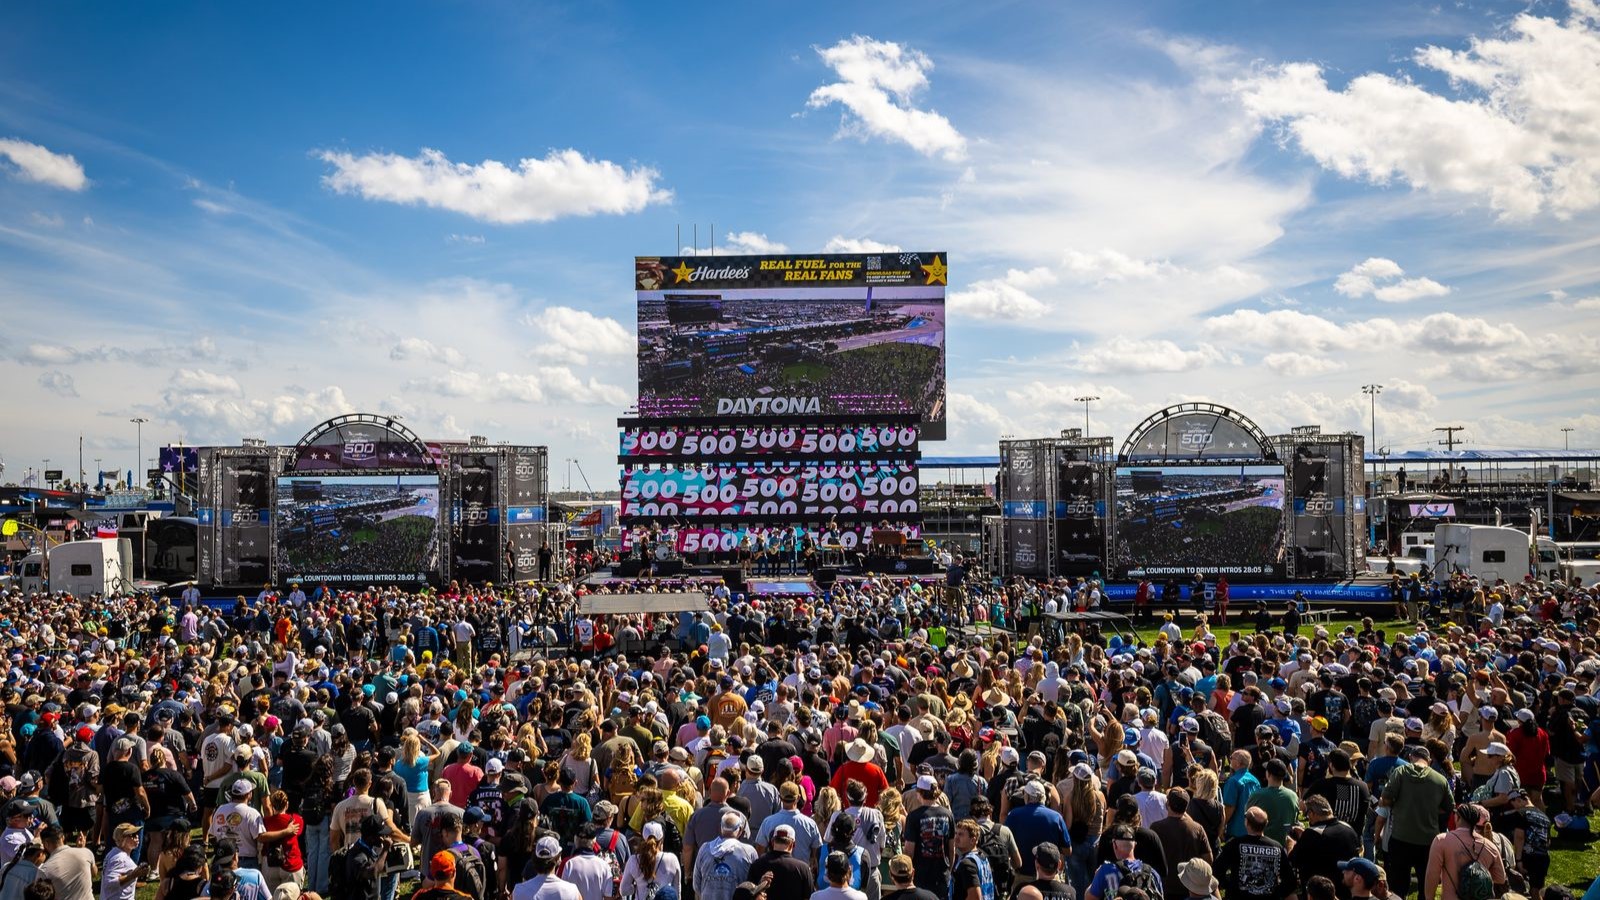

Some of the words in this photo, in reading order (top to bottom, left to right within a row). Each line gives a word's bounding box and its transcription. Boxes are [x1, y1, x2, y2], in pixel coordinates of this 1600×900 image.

[760, 260, 792, 270] REAL
[794, 260, 826, 269] FUEL
[688, 266, 750, 282] Hardee's
[784, 271, 817, 281] REAL
[820, 270, 854, 280] FANS
[717, 397, 820, 414] DAYTONA
[622, 432, 677, 450] 500
[682, 435, 736, 454] 500
[741, 430, 796, 448] 500
[801, 434, 856, 453] 500
[861, 428, 916, 446] 500
[1182, 434, 1212, 444] 500
[344, 443, 374, 453] 500
[515, 465, 534, 474] 500
[1012, 460, 1033, 470] 500
[623, 480, 678, 498] 500
[682, 485, 737, 503] 500
[742, 478, 797, 497] 500
[801, 483, 857, 502] 500
[861, 476, 917, 496] 500
[1306, 501, 1334, 510] 500
[518, 557, 536, 567] 500
[1242, 846, 1279, 856] STURGIS
